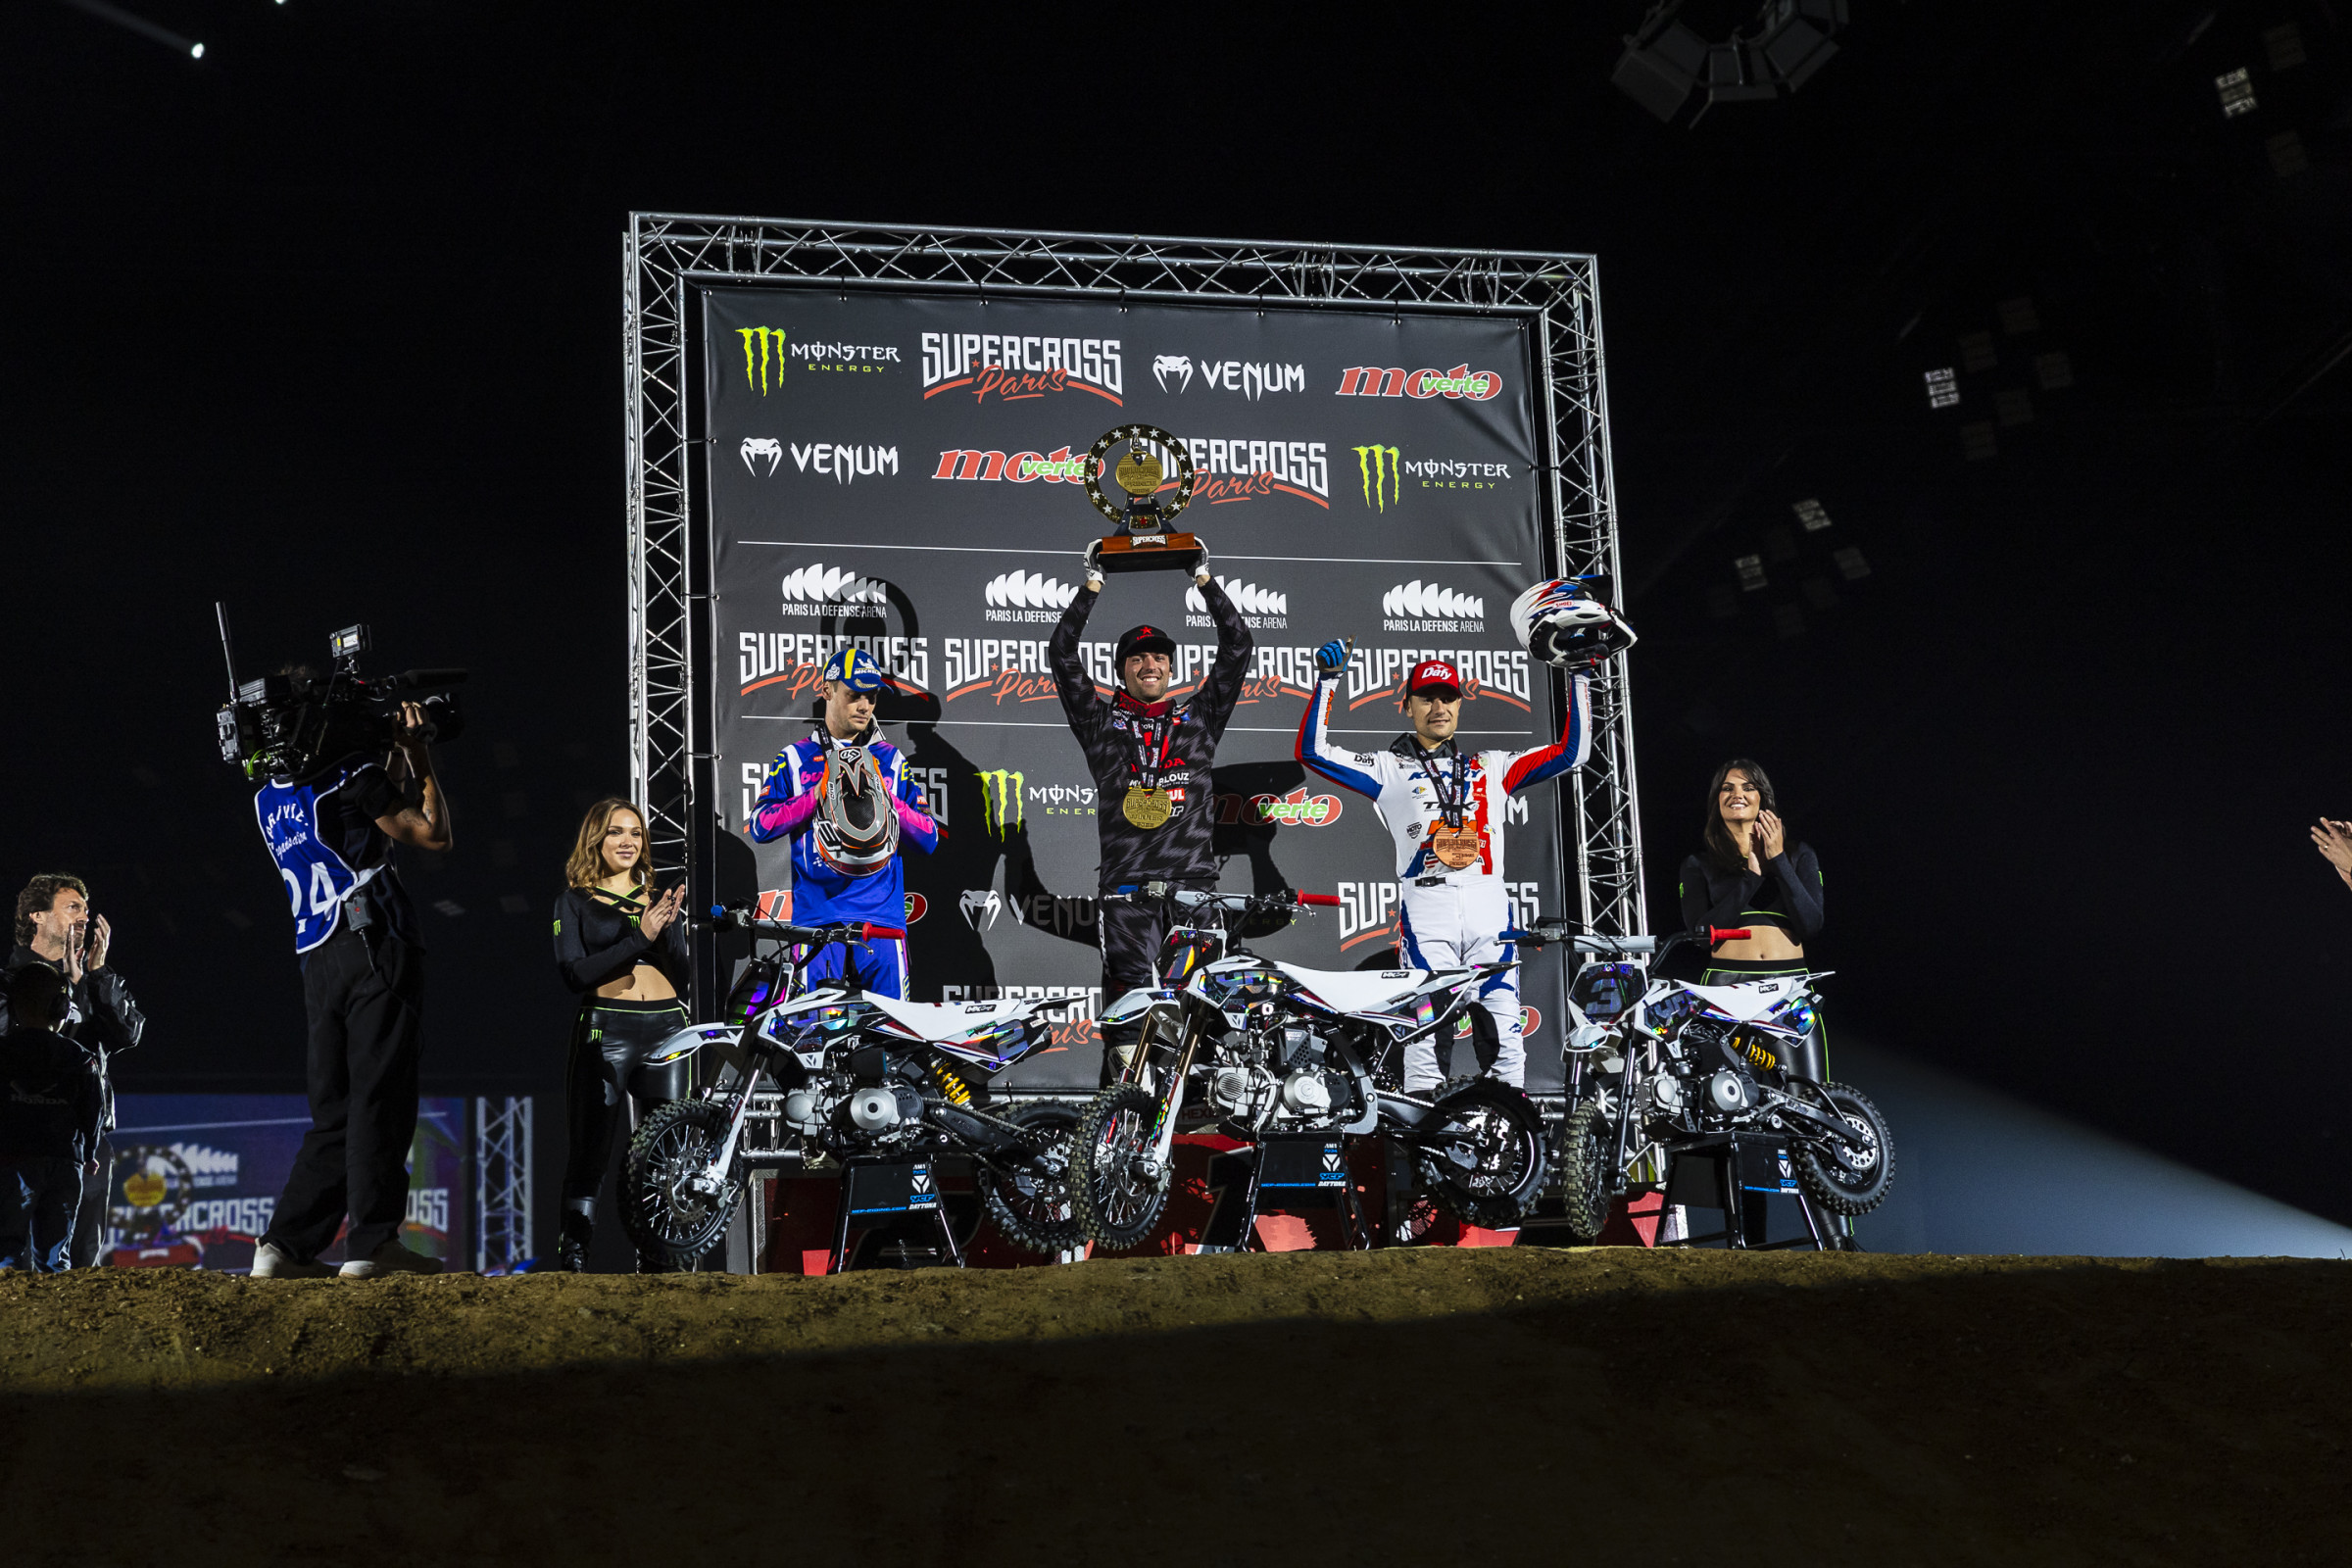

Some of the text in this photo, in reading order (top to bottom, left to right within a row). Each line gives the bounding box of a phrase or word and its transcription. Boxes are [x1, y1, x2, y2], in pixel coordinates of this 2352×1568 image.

[792, 342, 902, 363] MONSTER
[808, 364, 885, 373] ENERGY
[921, 332, 1123, 395] SUPERCROSS
[972, 364, 1068, 404] Paris
[1200, 359, 1305, 402] VENUM
[1336, 364, 1502, 401] moto
[1422, 375, 1490, 394] verte
[791, 441, 899, 485] VENUM
[932, 446, 1105, 484] moto
[1404, 459, 1512, 479] MONSTER
[1422, 480, 1495, 489] ENERGY
[1132, 534, 1167, 546] SUPERCROSS
[782, 604, 887, 618] PARIS LA DEFENSE ARENA
[986, 610, 1011, 622] PARIS
[1012, 611, 1023, 622] LA
[1186, 614, 1211, 627] PARIS
[1262, 616, 1288, 629] ARENA
[1384, 618, 1485, 633] PARIS LA DEFENSE ARENA
[1421, 666, 1452, 680] Dafy
[1258, 801, 1329, 819] verte
[1585, 978, 1628, 1015] 3
[993, 1018, 1029, 1062] 2
